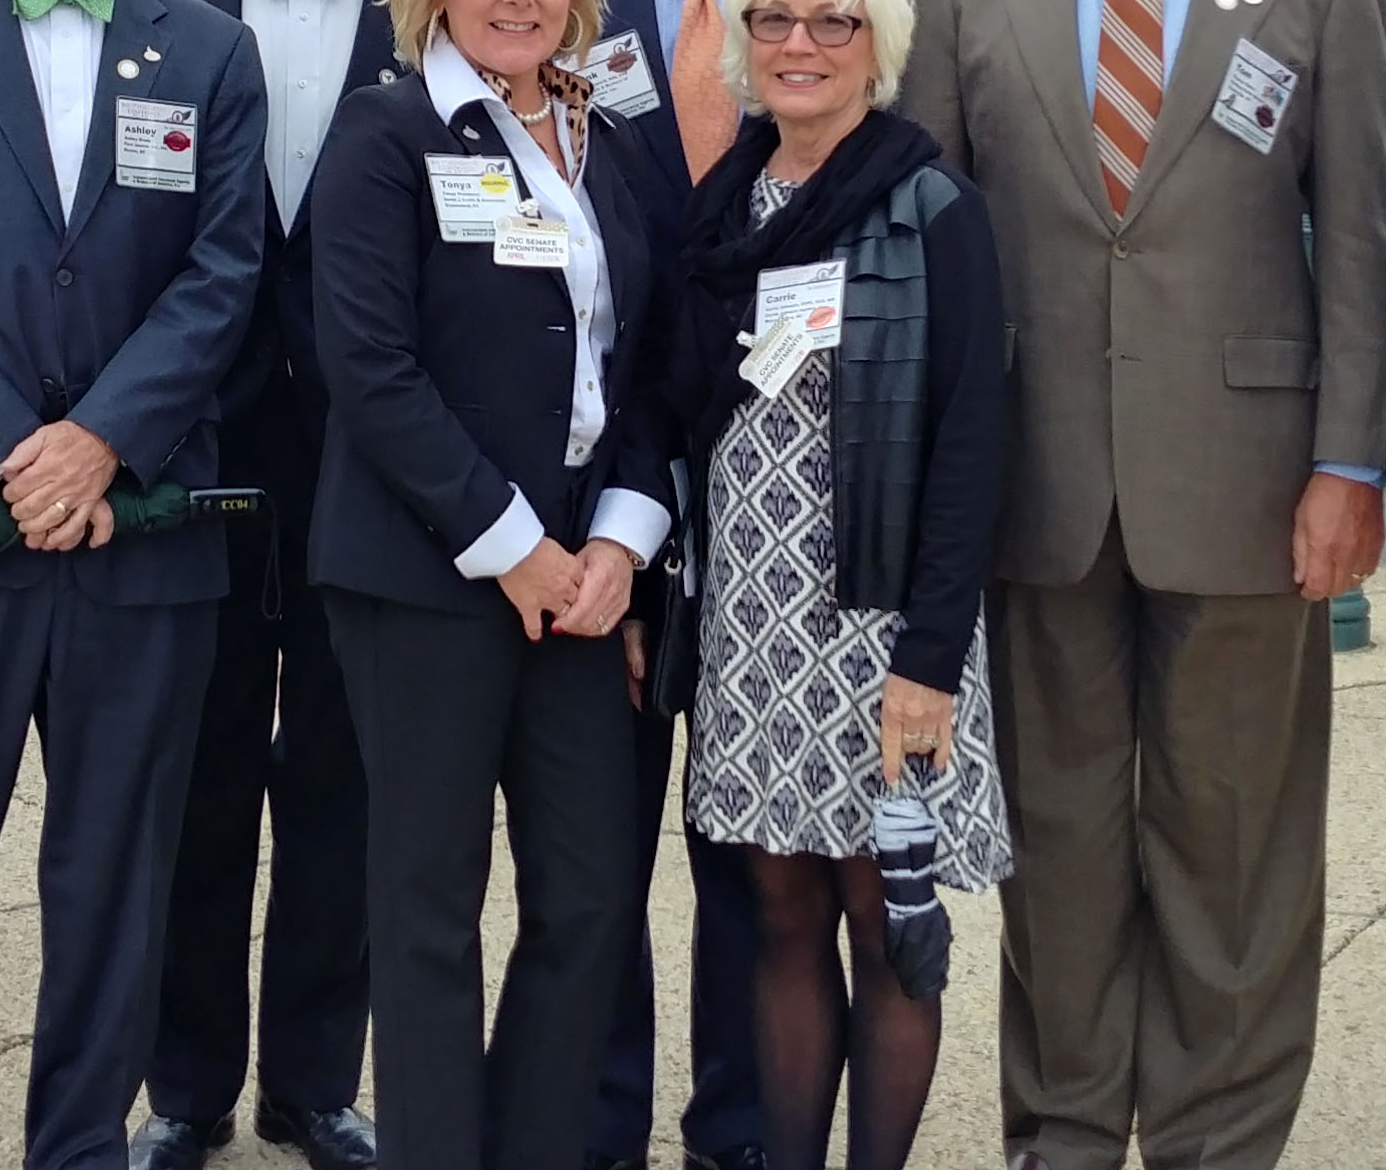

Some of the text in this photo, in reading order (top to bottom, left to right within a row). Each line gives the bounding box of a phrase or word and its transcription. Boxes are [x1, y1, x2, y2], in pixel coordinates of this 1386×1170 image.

[124, 125, 157, 138] Ashley
[439, 180, 472, 191] Tonya
[506, 236, 558, 246] CVC SENATE
[499, 243, 564, 254] APPOINTMENTS
[766, 292, 797, 304] Carrie
[771, 333, 794, 361] SENATE
[761, 333, 804, 387] APPOINTMENTS
